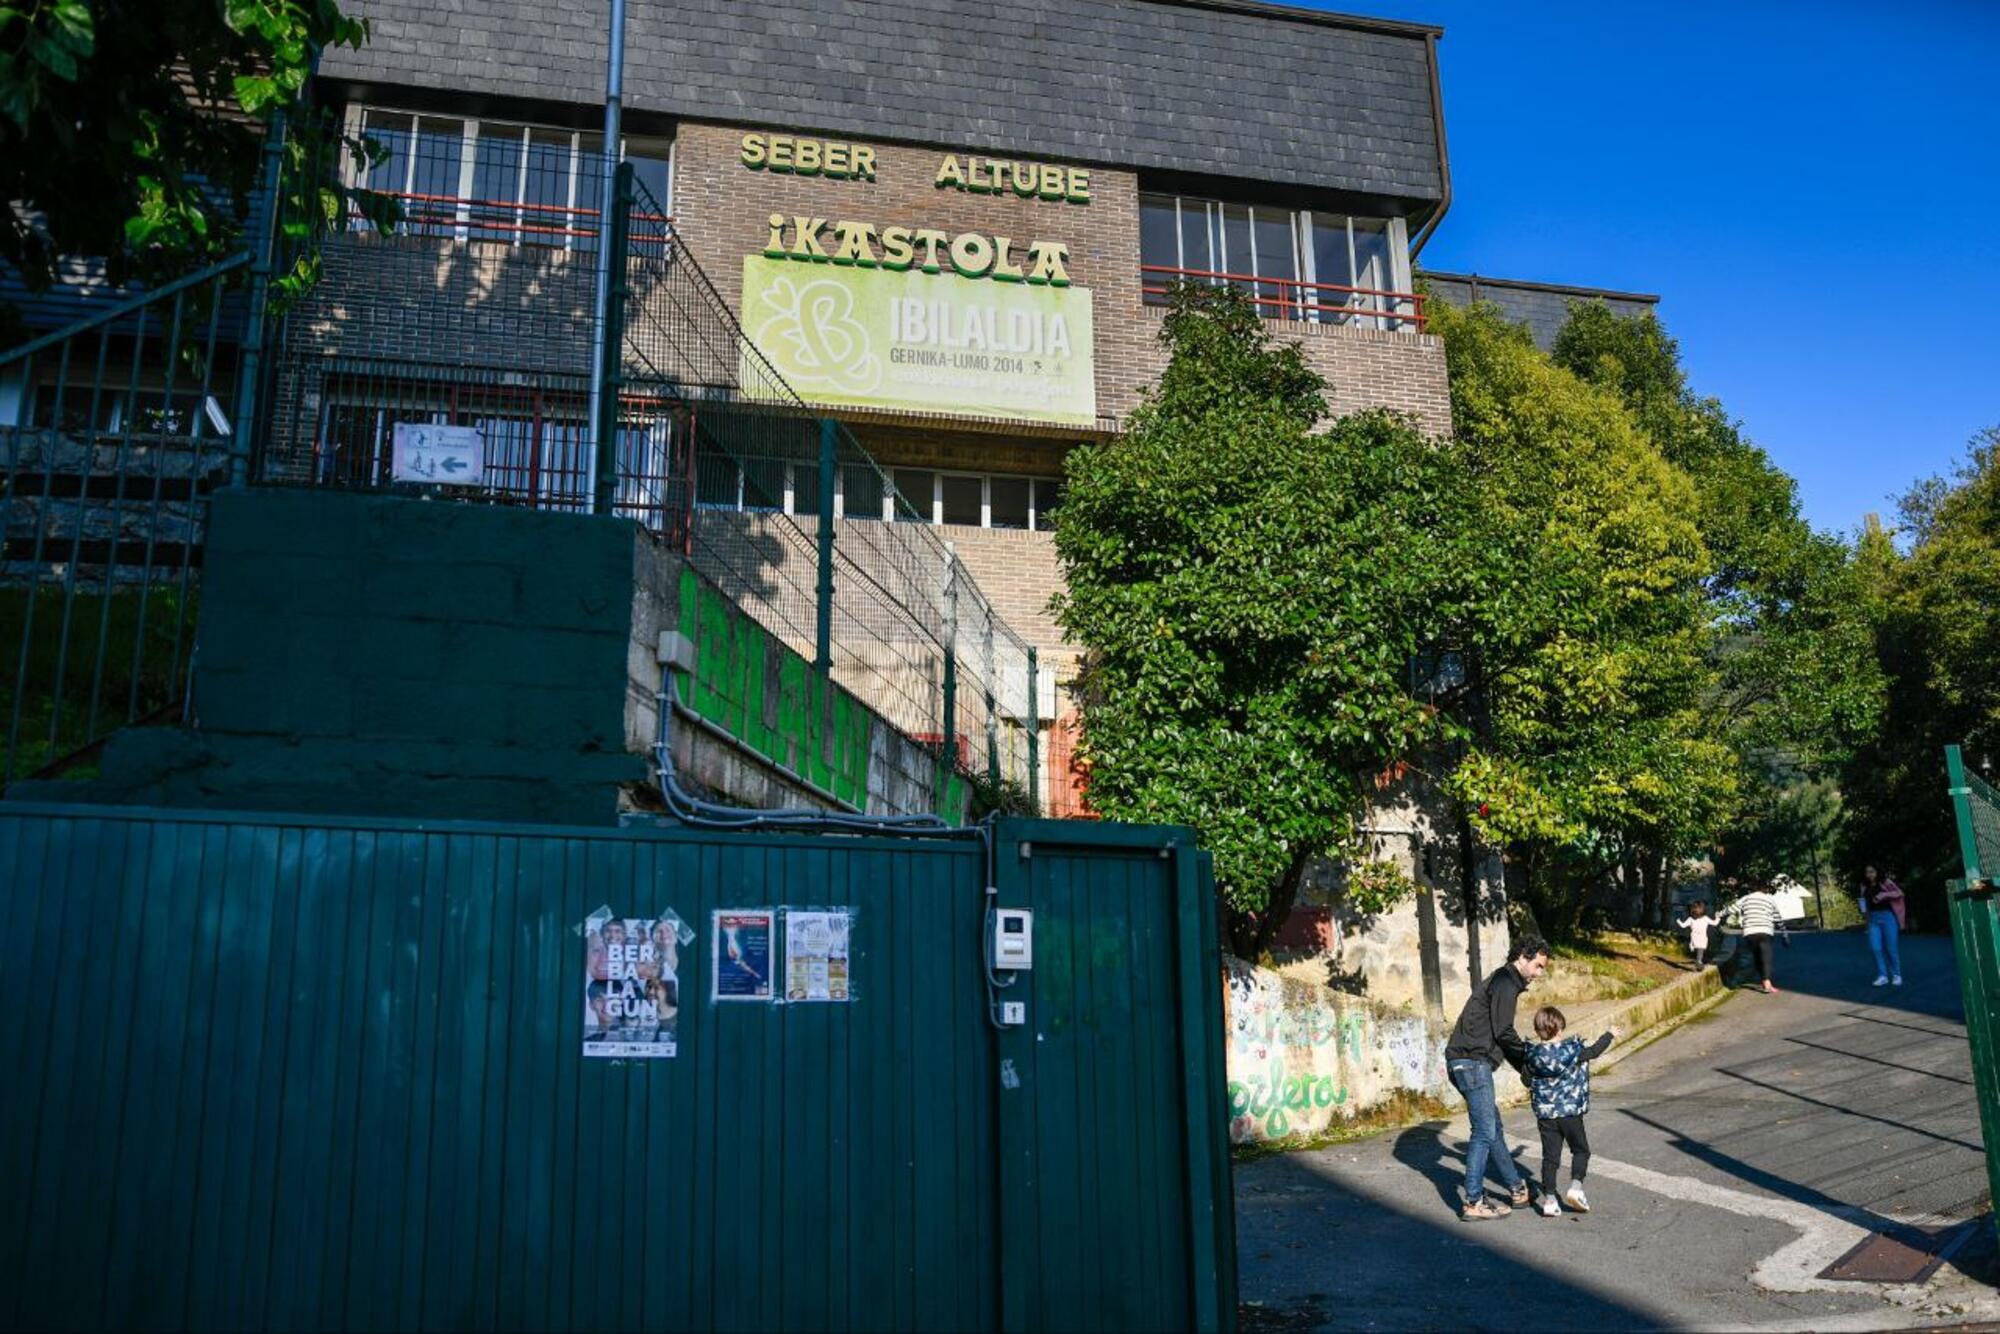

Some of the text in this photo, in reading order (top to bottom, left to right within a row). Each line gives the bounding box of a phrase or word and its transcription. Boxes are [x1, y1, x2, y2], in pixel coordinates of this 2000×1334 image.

[740, 133, 1091, 203] SEBER ALTUBE
[889, 294, 1073, 358] IBILALDIA
[890, 347, 1024, 374] GERNIKA-LUMO 2014
[607, 943, 656, 962] BER
[607, 962, 639, 980] BA
[606, 980, 637, 999] LA
[605, 999, 658, 1019] GUN
